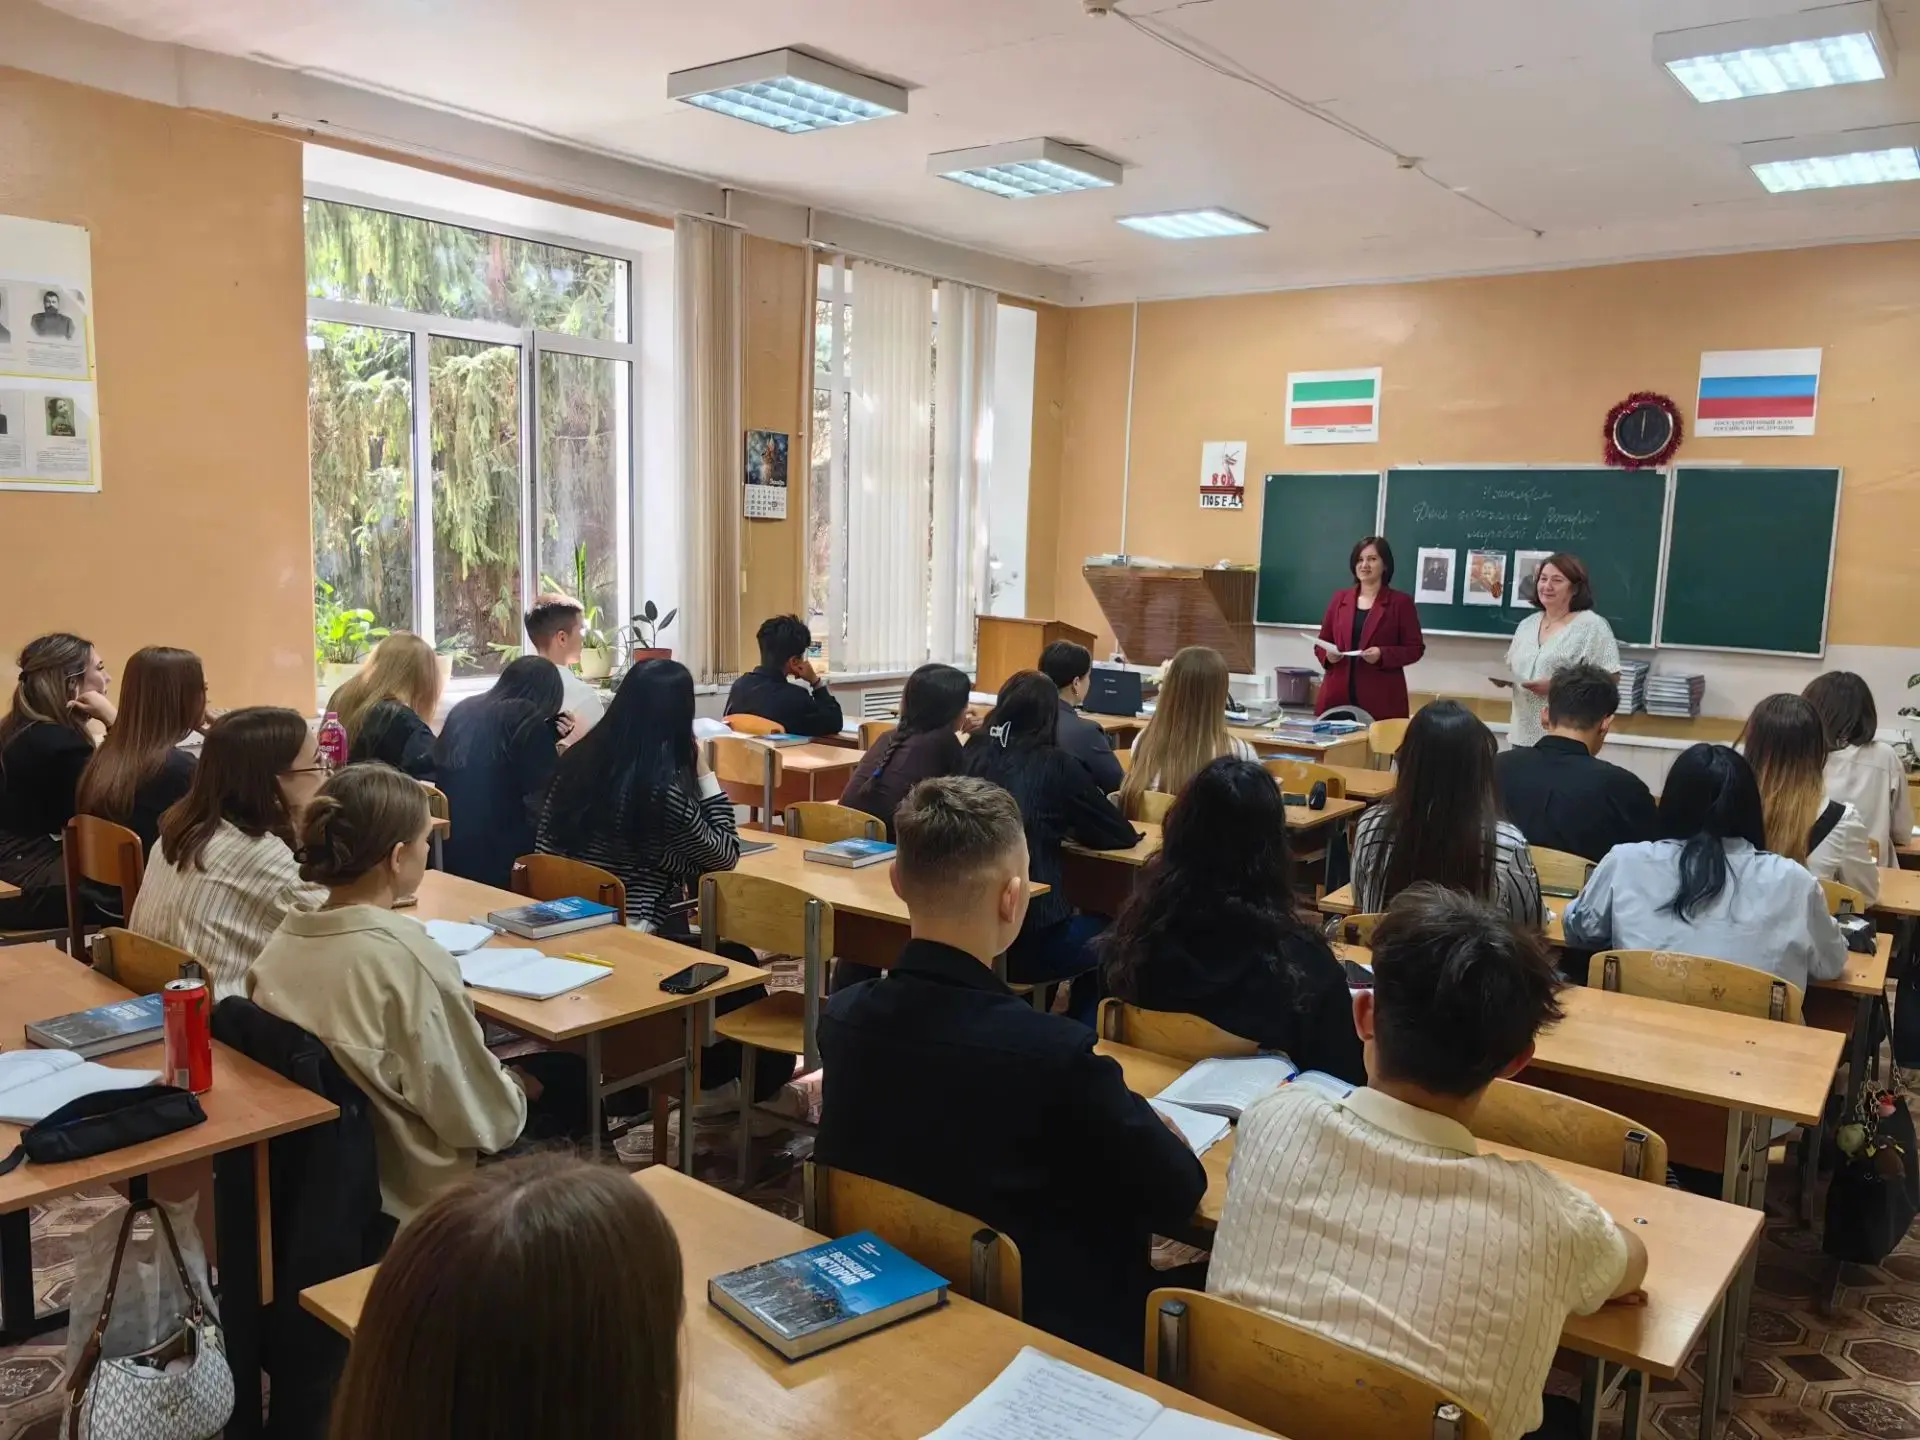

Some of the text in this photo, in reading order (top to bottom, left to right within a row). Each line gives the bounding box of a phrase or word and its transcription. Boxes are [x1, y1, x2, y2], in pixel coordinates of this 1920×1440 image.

[1202, 494, 1241, 507] ПОБЕД
[812, 1255, 862, 1286] ИСТОРИЯ
[829, 1251, 876, 1281] ВСЕОБЩАЯ
